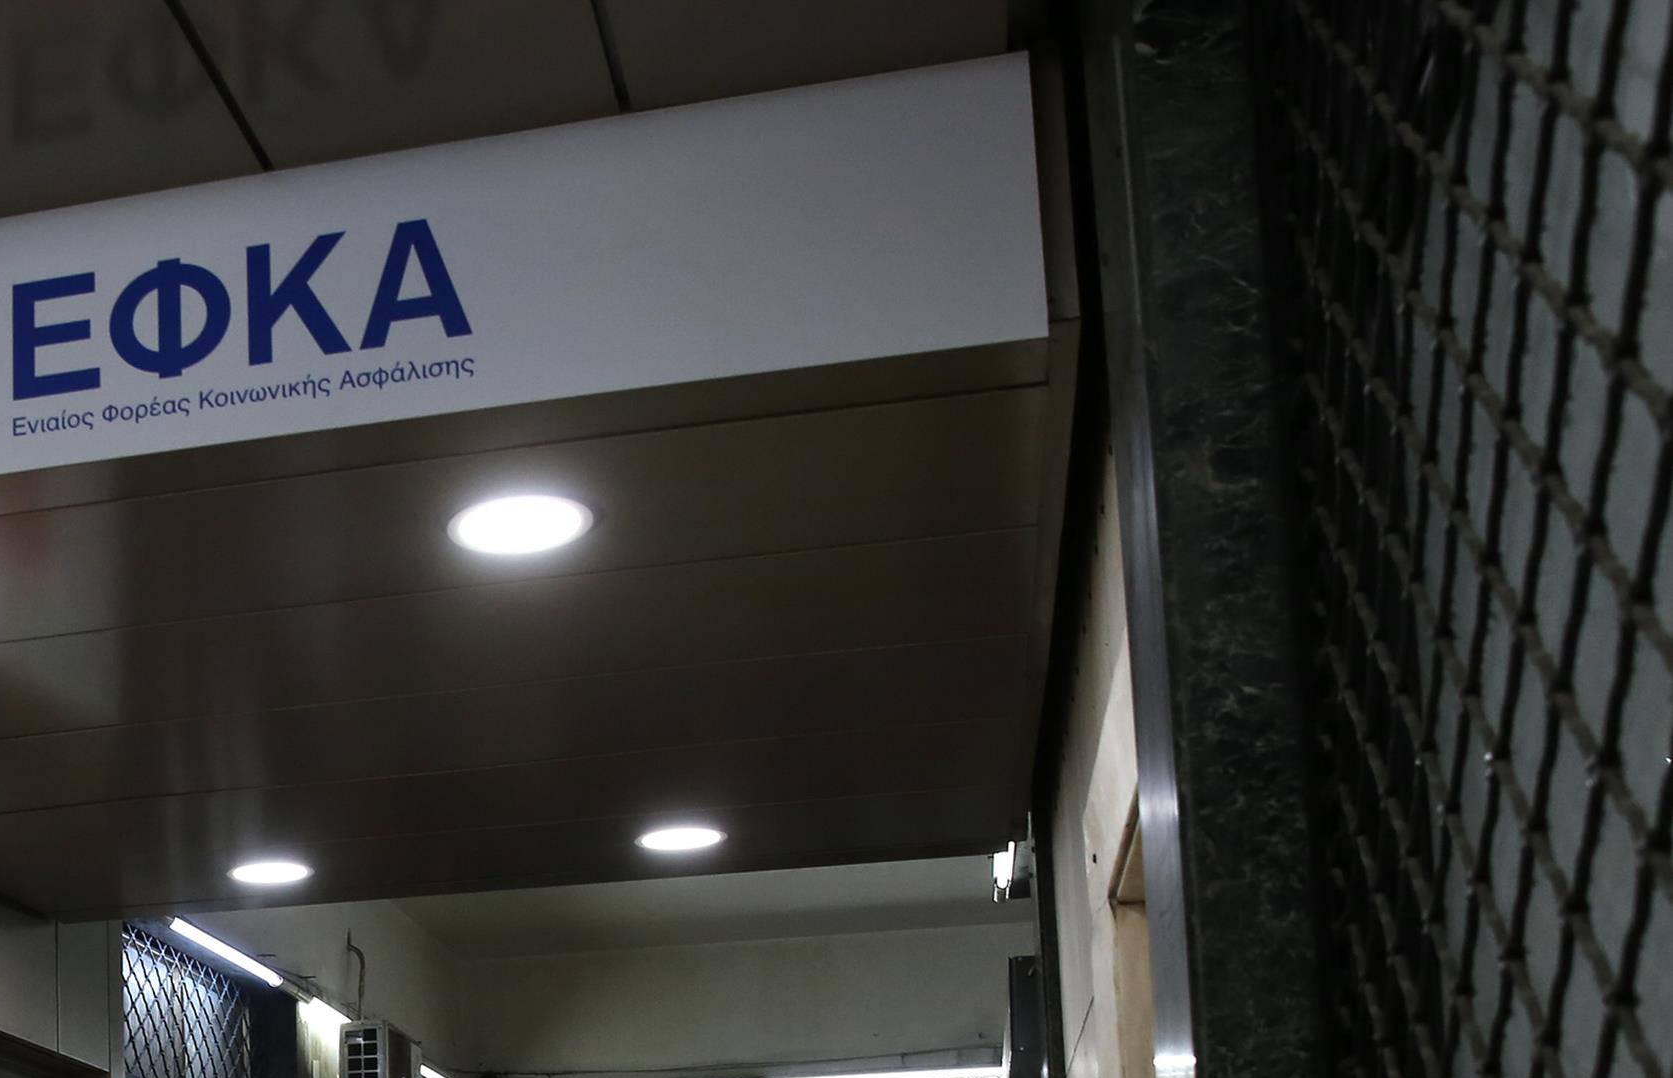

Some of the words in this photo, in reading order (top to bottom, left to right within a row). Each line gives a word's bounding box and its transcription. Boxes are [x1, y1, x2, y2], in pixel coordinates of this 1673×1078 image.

[12, 218, 473, 400] ΕΦΚΑ
[12, 408, 95, 437] Ενιαίος
[102, 396, 191, 425] Φορέας
[199, 373, 331, 411] Κοινωνικής
[340, 356, 475, 392] Ασφάλισης
